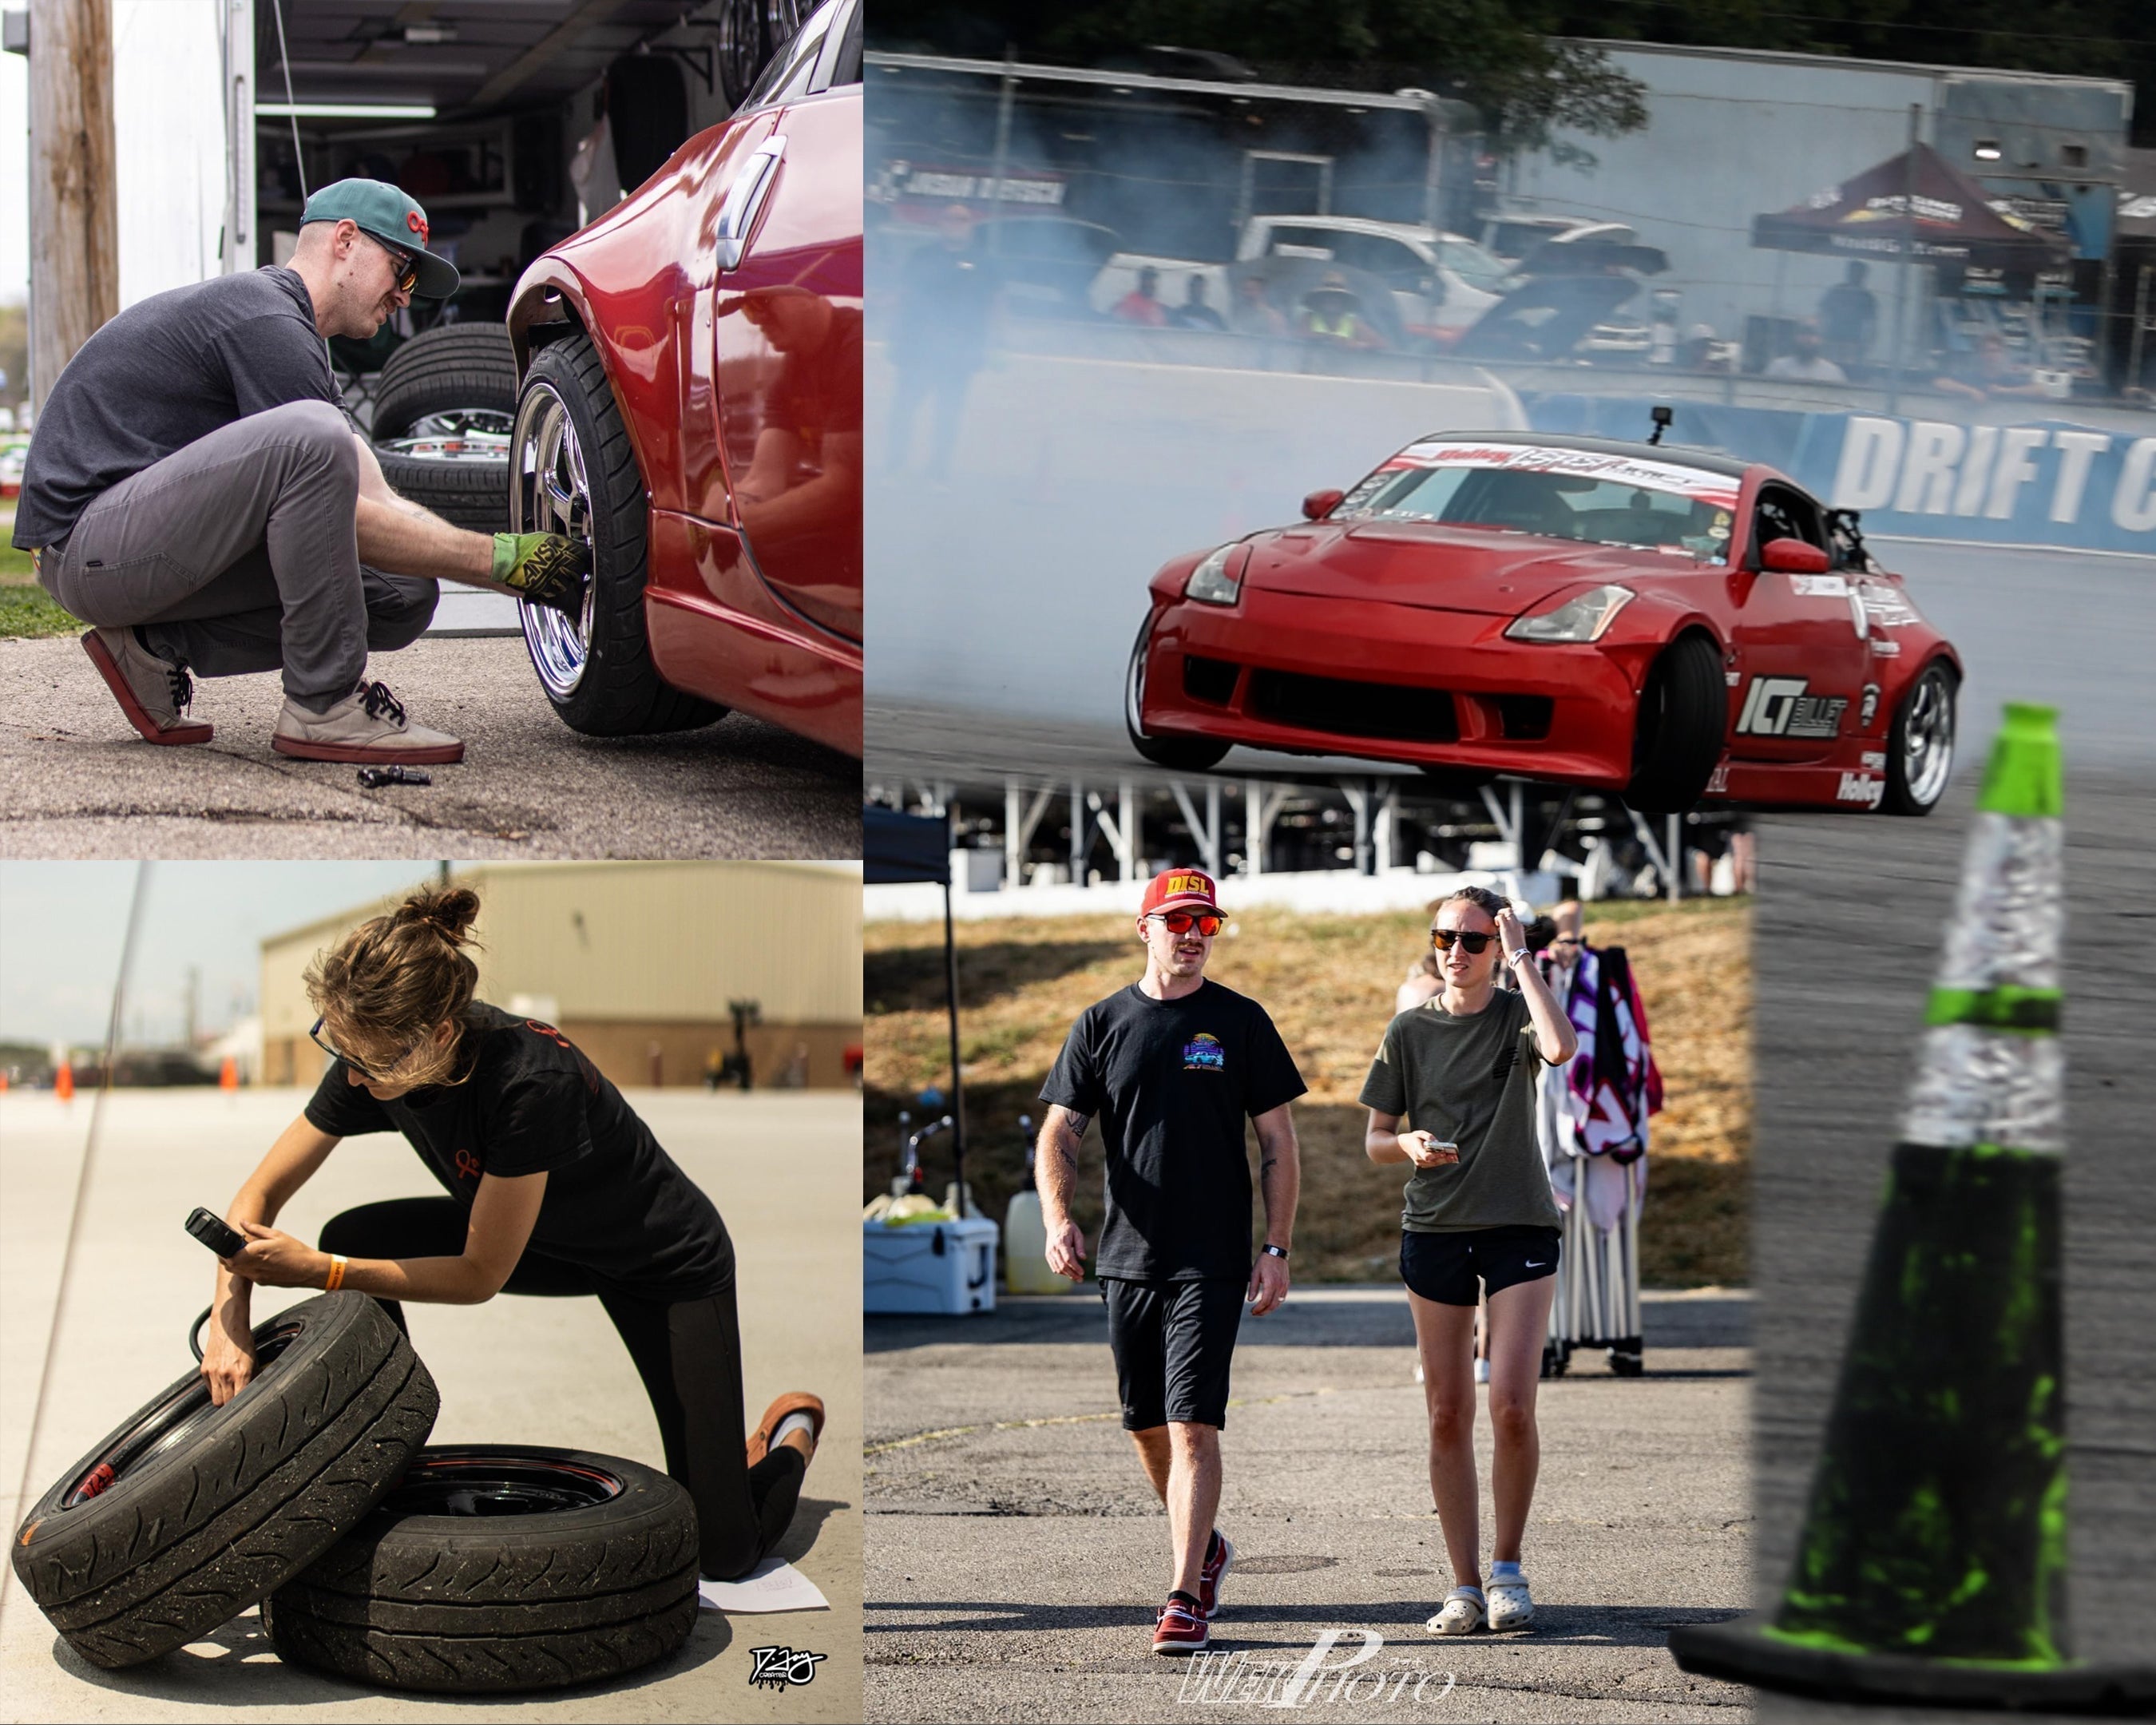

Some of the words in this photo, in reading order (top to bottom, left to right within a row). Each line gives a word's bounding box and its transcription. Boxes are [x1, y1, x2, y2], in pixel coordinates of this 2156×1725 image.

[1831, 416, 2111, 524] DRIFT
[523, 534, 565, 587] ANSR
[1736, 677, 1808, 734] ICT
[1167, 875, 1210, 894] DISL
